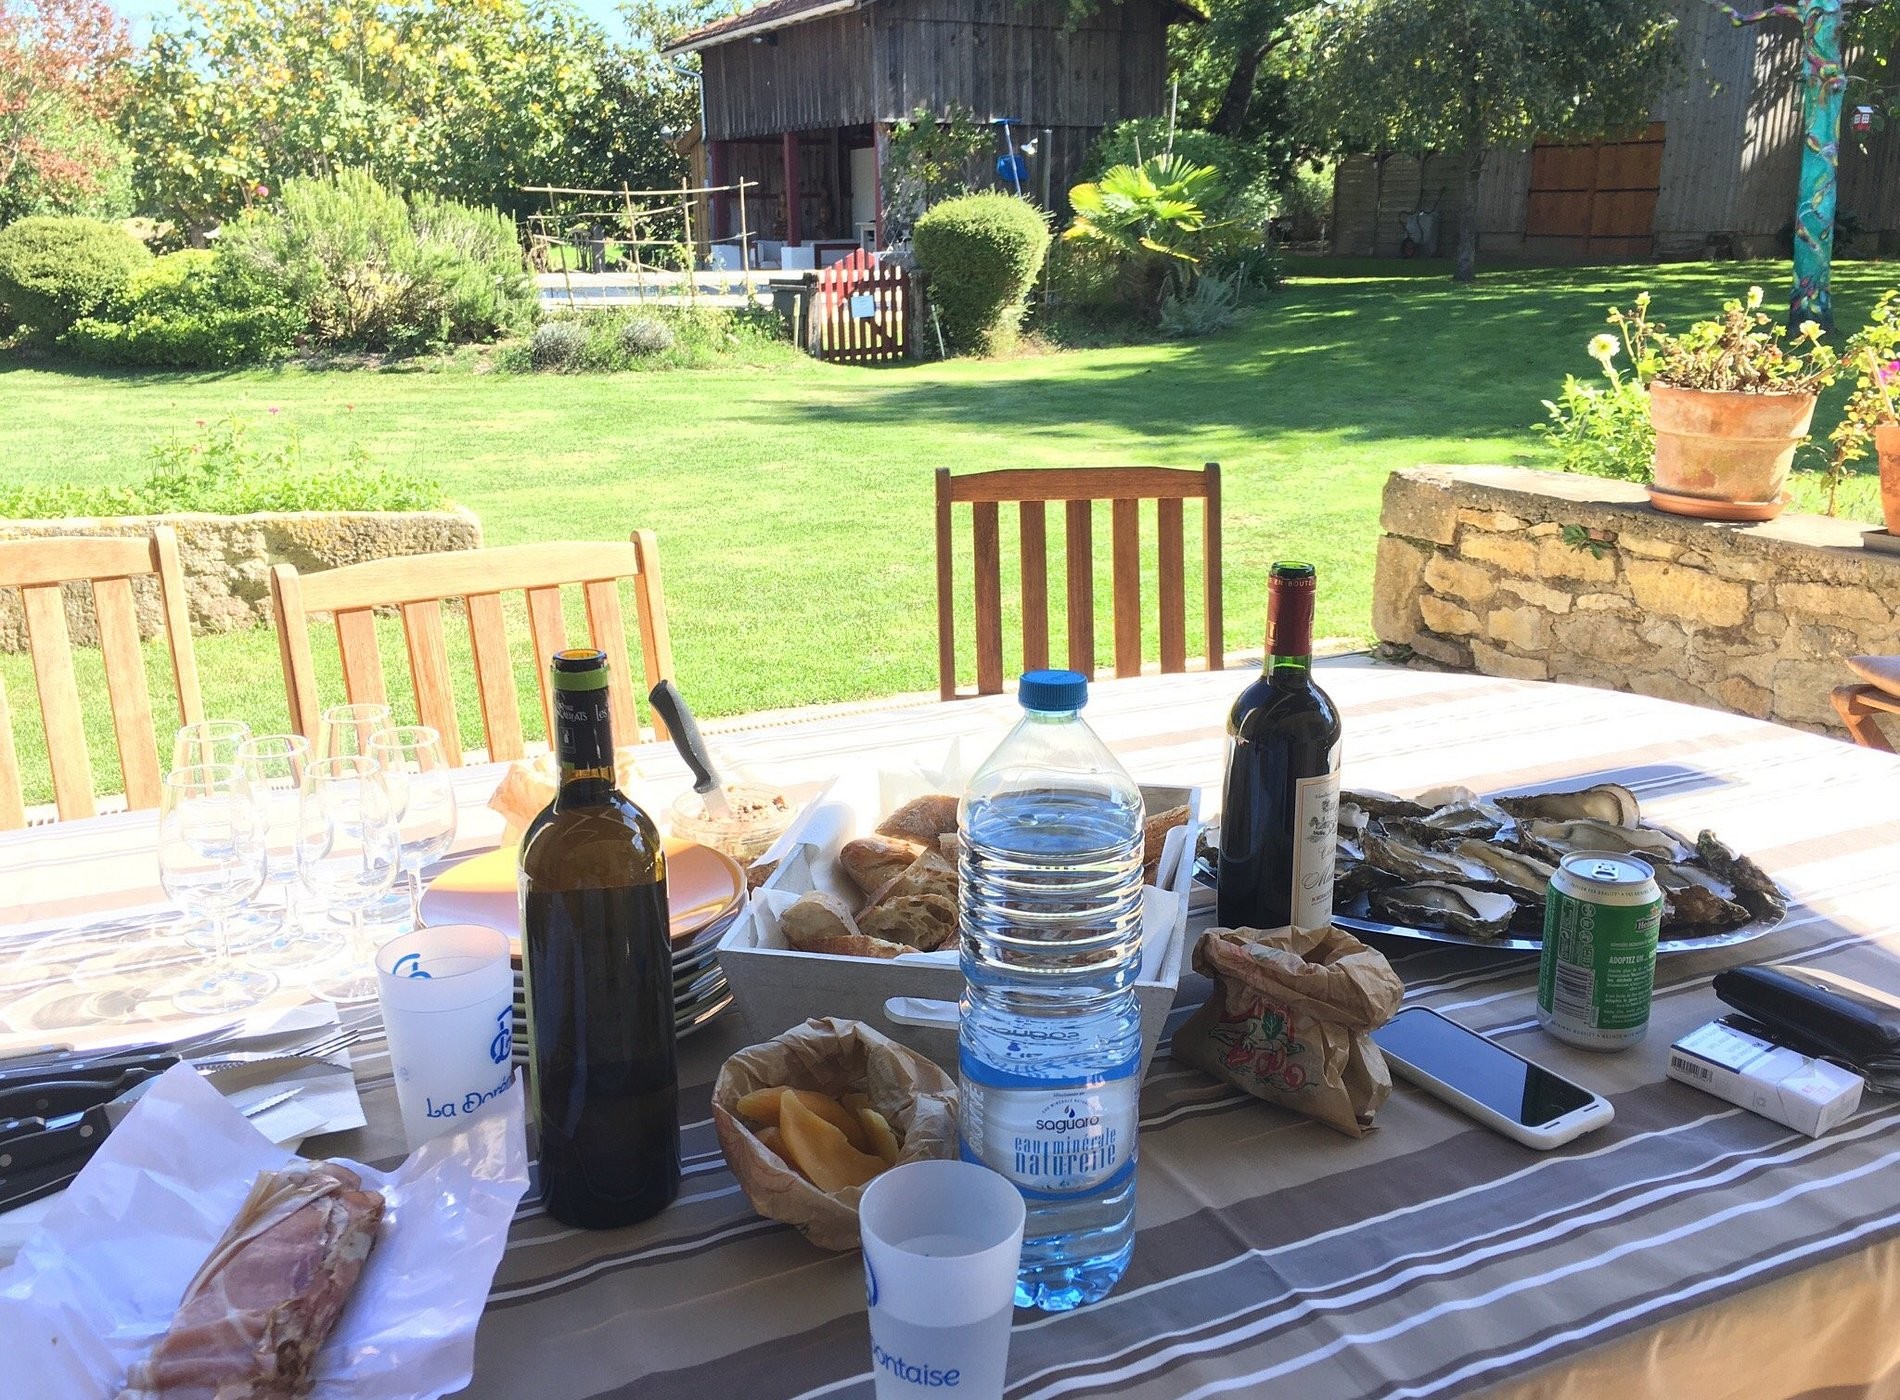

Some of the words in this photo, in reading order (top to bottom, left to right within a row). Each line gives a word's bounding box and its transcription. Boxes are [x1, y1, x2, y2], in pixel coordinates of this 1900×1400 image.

[426, 1097, 457, 1118] La
[1036, 1115, 1099, 1133] saguaro
[1015, 1137, 1041, 1154] eau
[1053, 1128, 1116, 1155] minérale
[1015, 1143, 1116, 1177] naturelle
